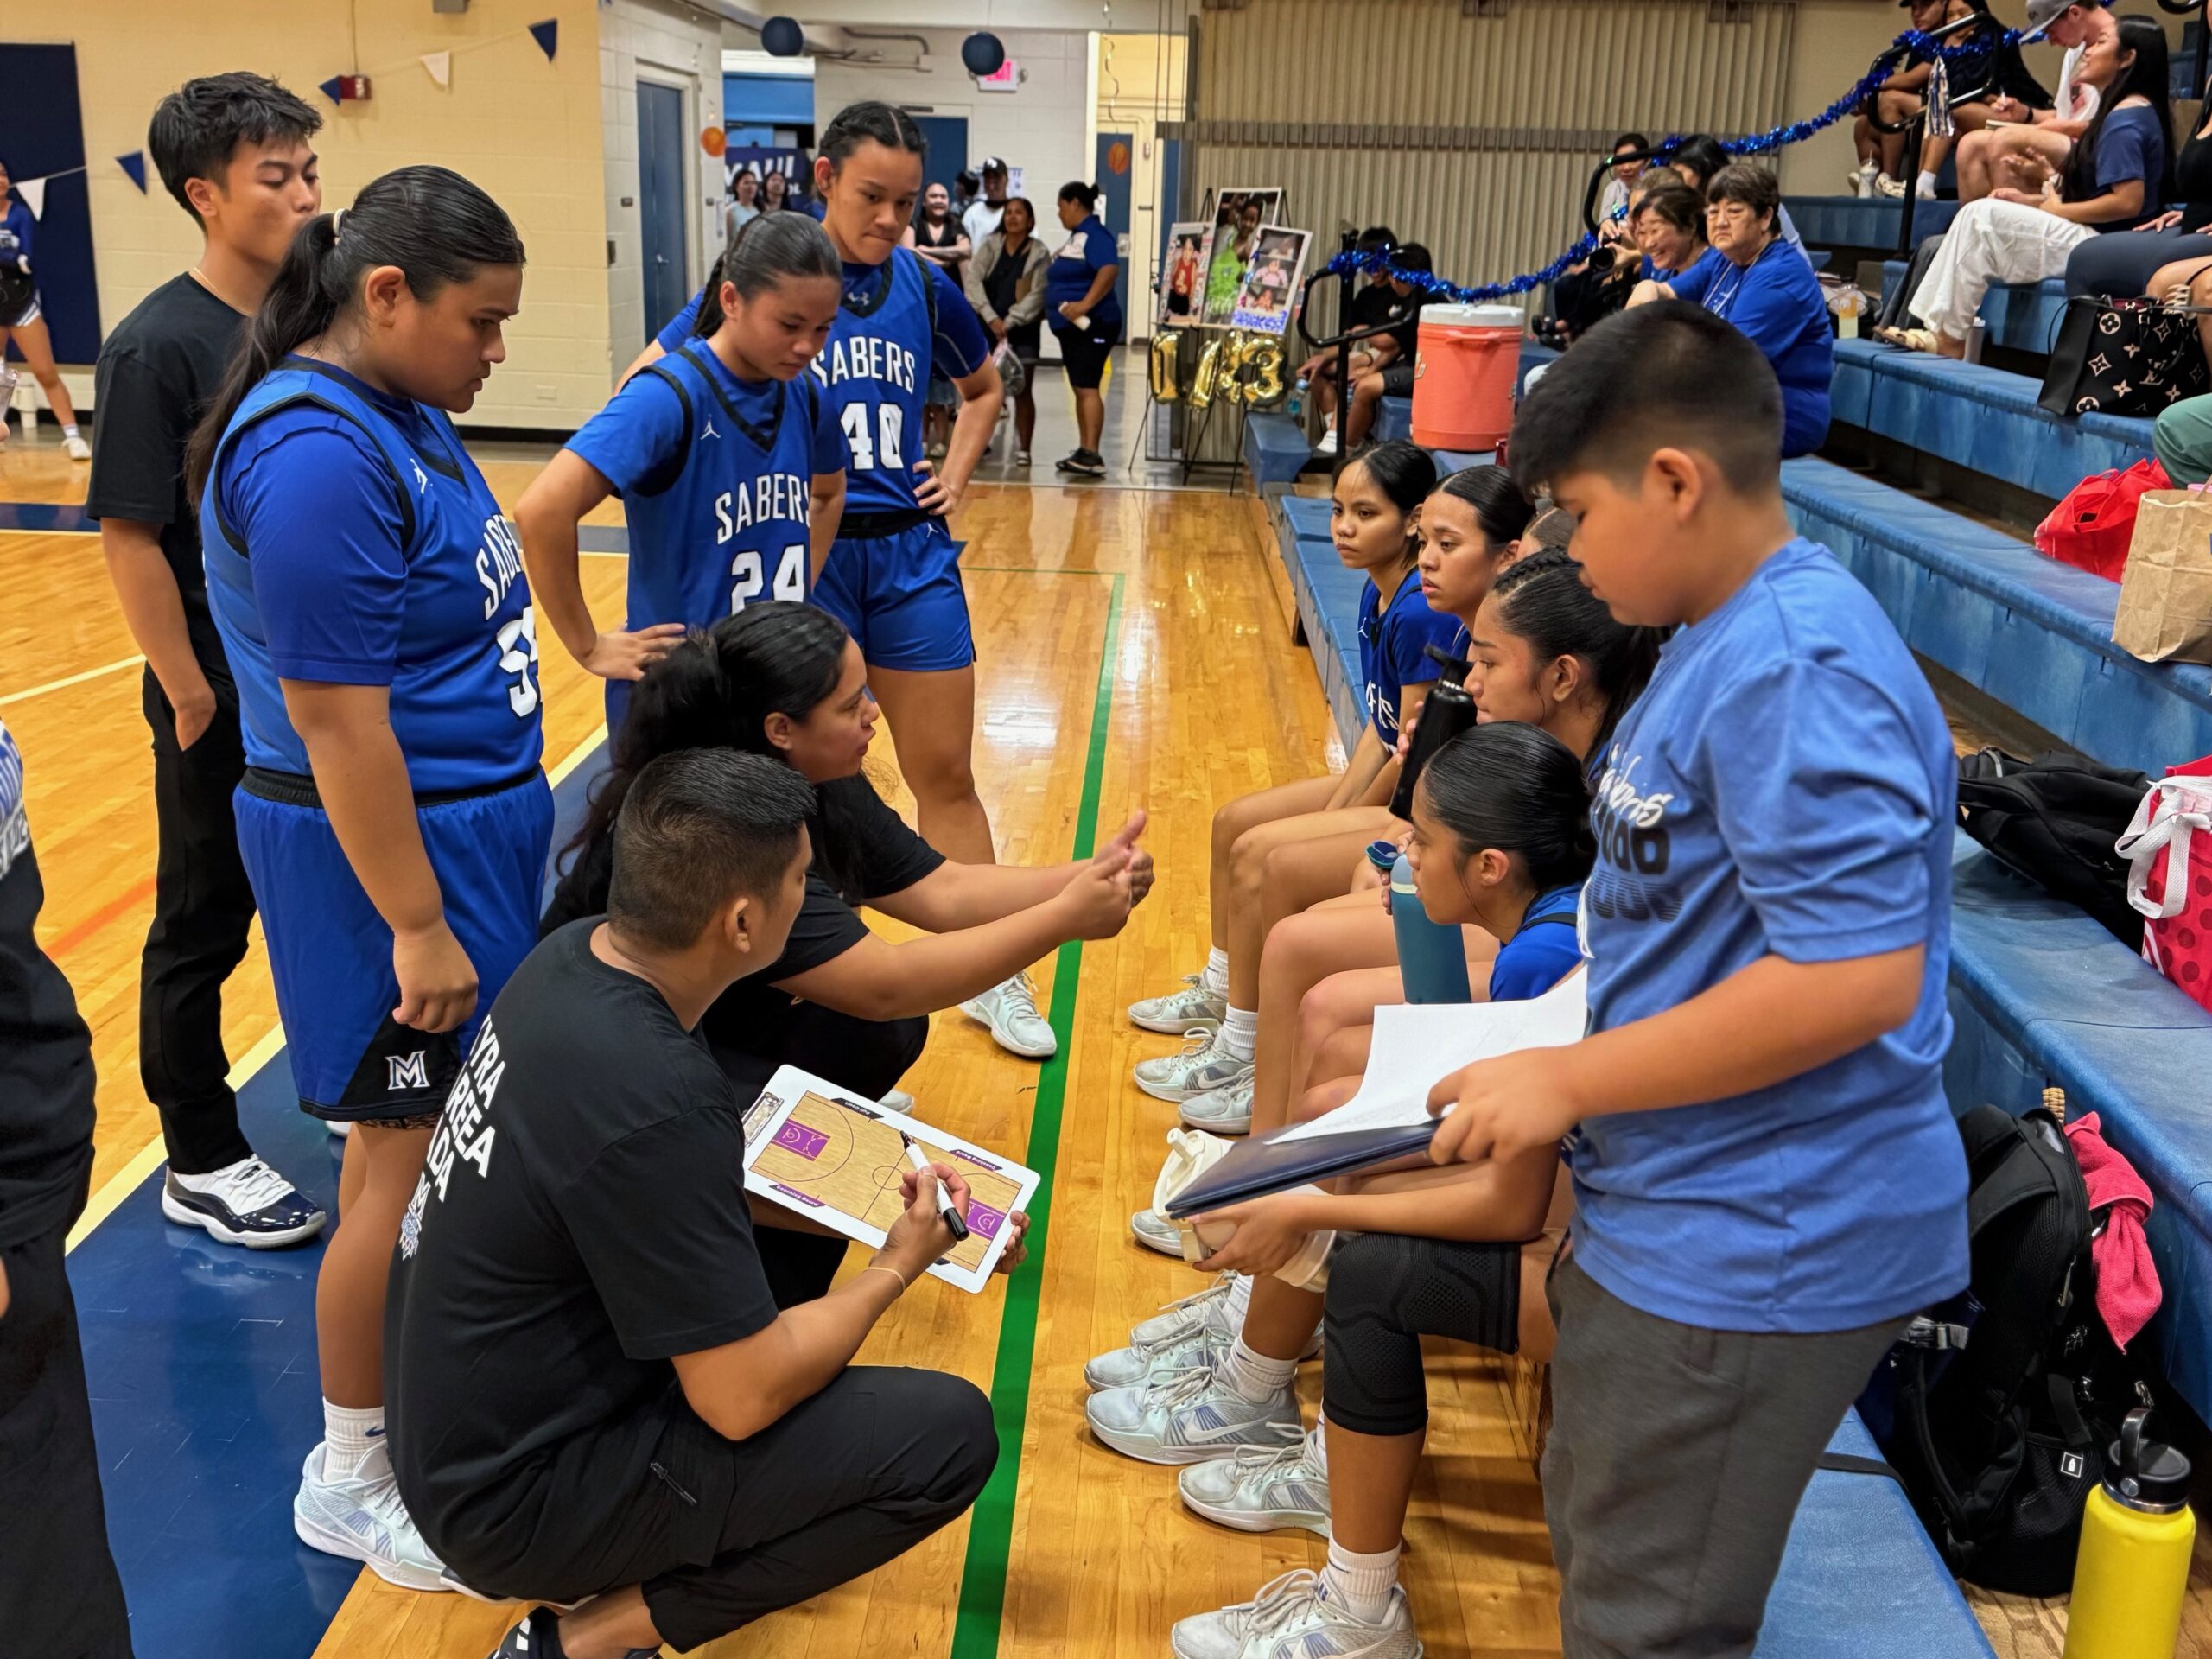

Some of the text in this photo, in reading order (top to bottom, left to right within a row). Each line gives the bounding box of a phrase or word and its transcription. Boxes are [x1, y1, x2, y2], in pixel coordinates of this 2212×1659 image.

[810, 335, 916, 396] SABERS
[840, 403, 904, 469] 40
[731, 544, 804, 616] 24
[385, 1050, 431, 1090] M
[469, 1014, 506, 1110] YRA
